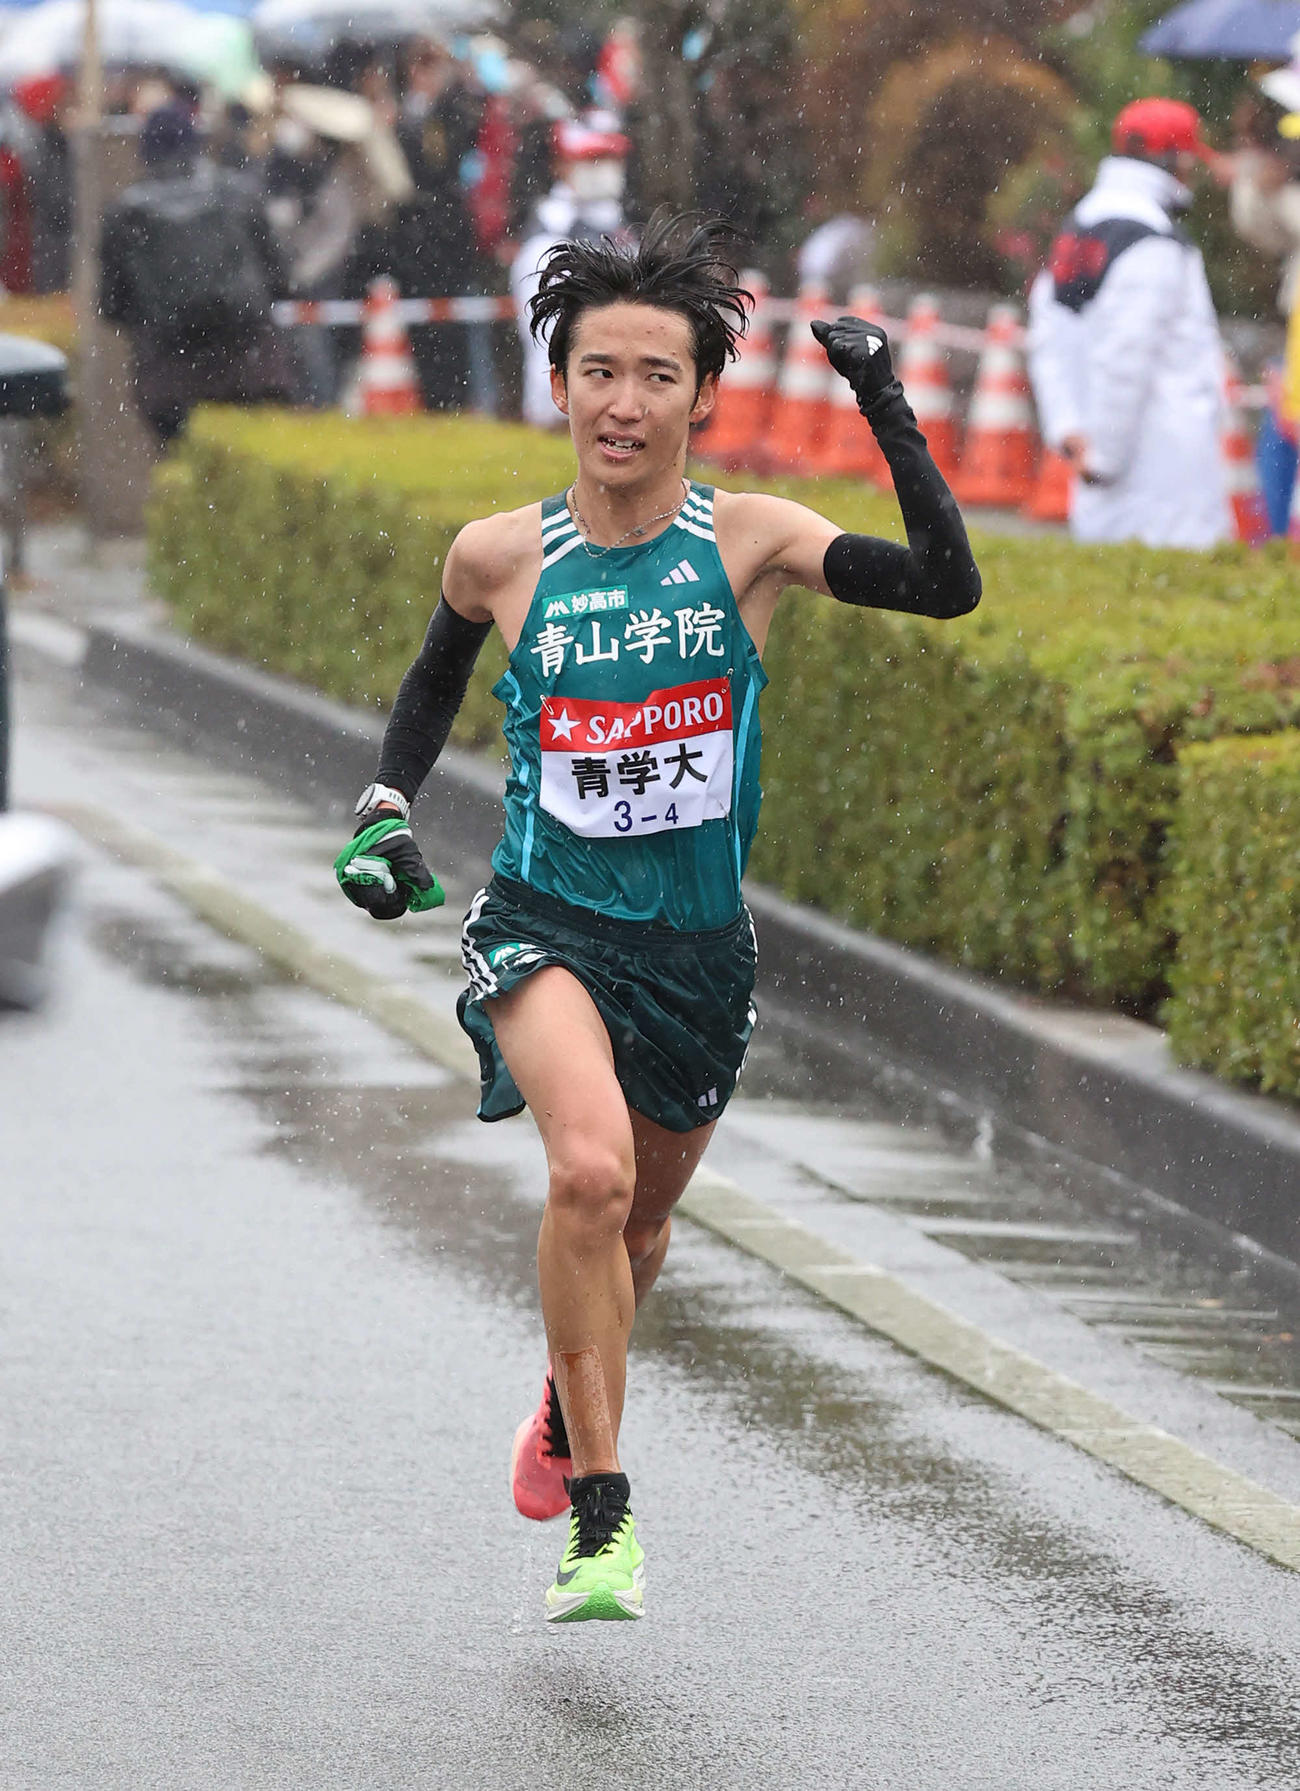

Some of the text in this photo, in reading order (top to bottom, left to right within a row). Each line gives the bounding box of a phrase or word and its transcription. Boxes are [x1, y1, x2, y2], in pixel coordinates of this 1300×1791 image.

[571, 589, 626, 614] 妙高市
[530, 602, 726, 677] 青山学院
[571, 743, 708, 800] 青学大
